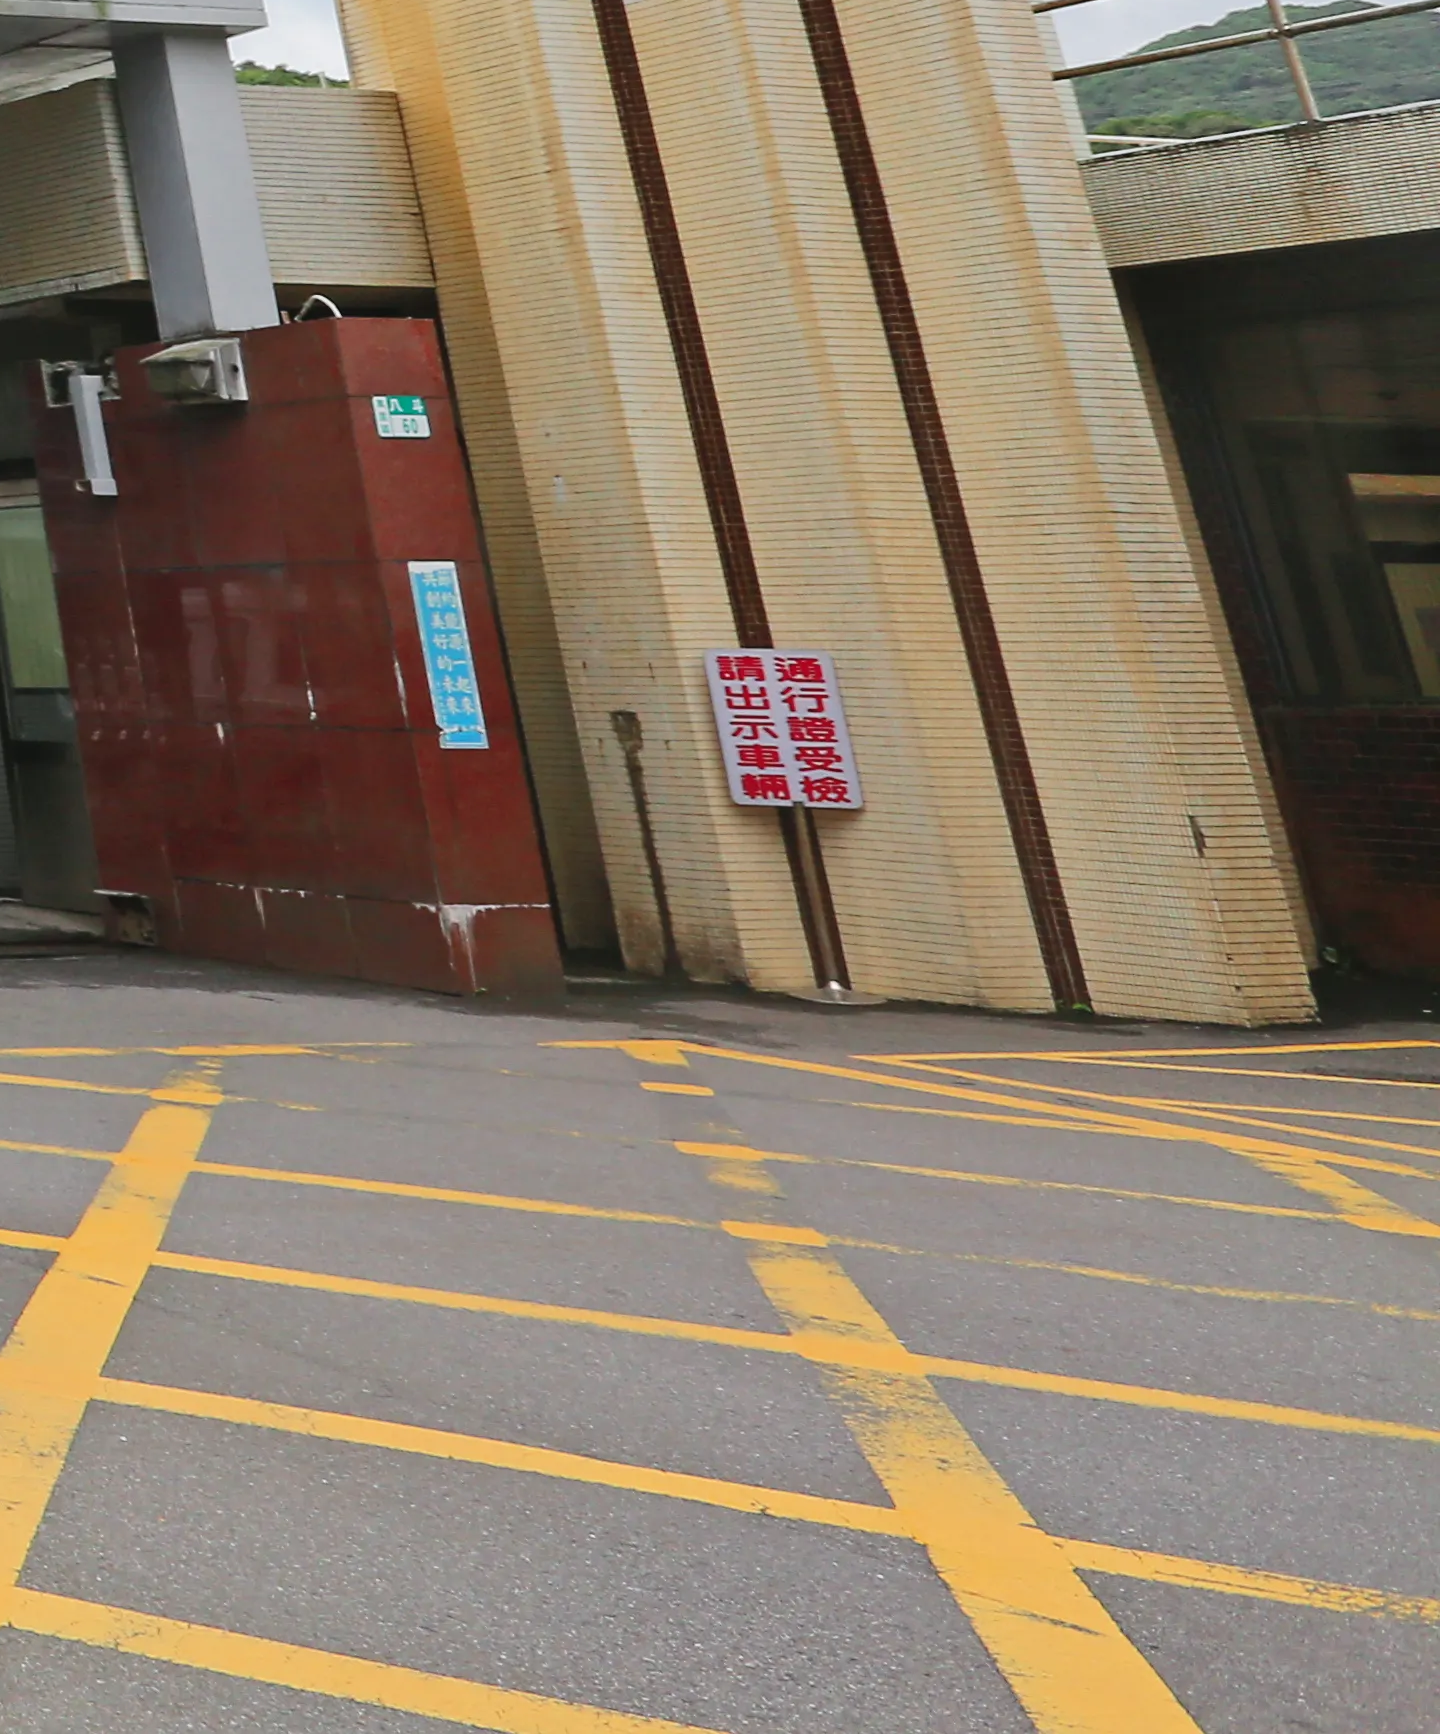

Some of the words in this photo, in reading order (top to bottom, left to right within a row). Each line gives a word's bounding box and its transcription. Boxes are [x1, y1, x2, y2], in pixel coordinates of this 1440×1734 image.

[716, 656, 791, 800] 請出示車輛
[774, 657, 851, 803] 通行證受檢
